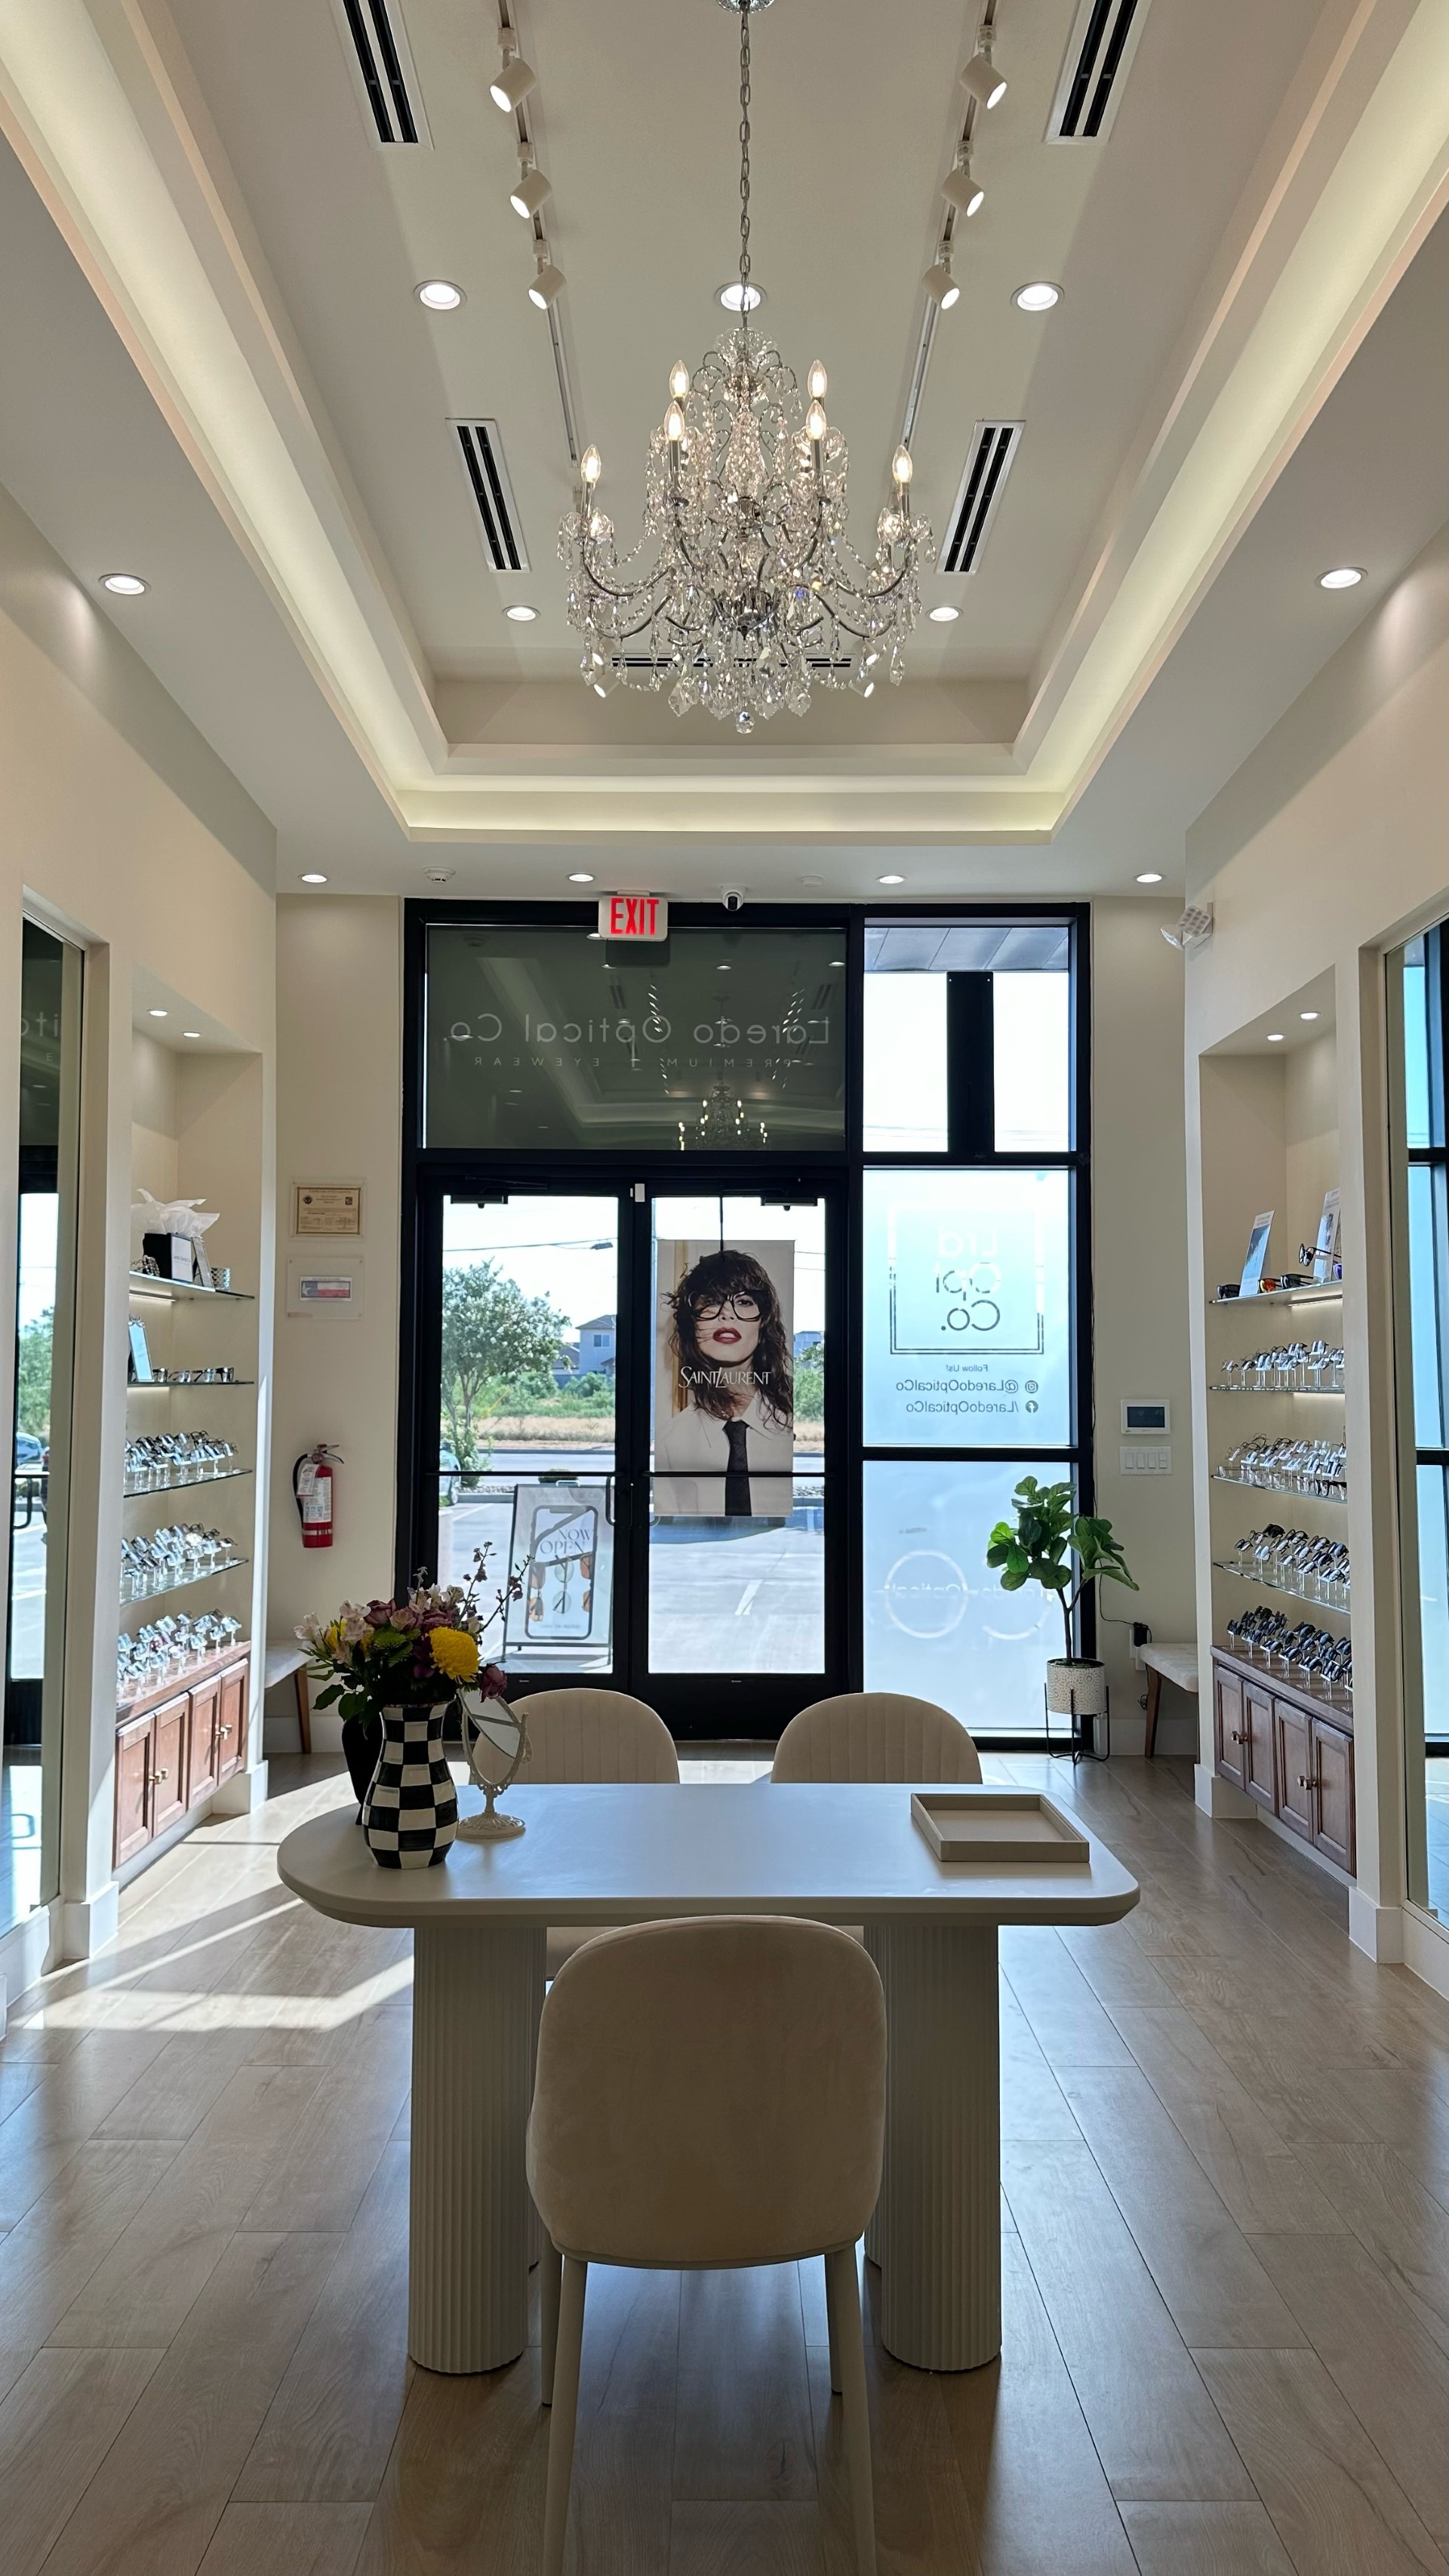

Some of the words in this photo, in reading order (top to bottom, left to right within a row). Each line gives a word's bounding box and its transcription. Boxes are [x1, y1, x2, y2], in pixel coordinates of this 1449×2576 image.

[610, 897, 660, 936] EXIT
[558, 1528, 592, 1540] NOW
[540, 1540, 585, 1554] OPEN
